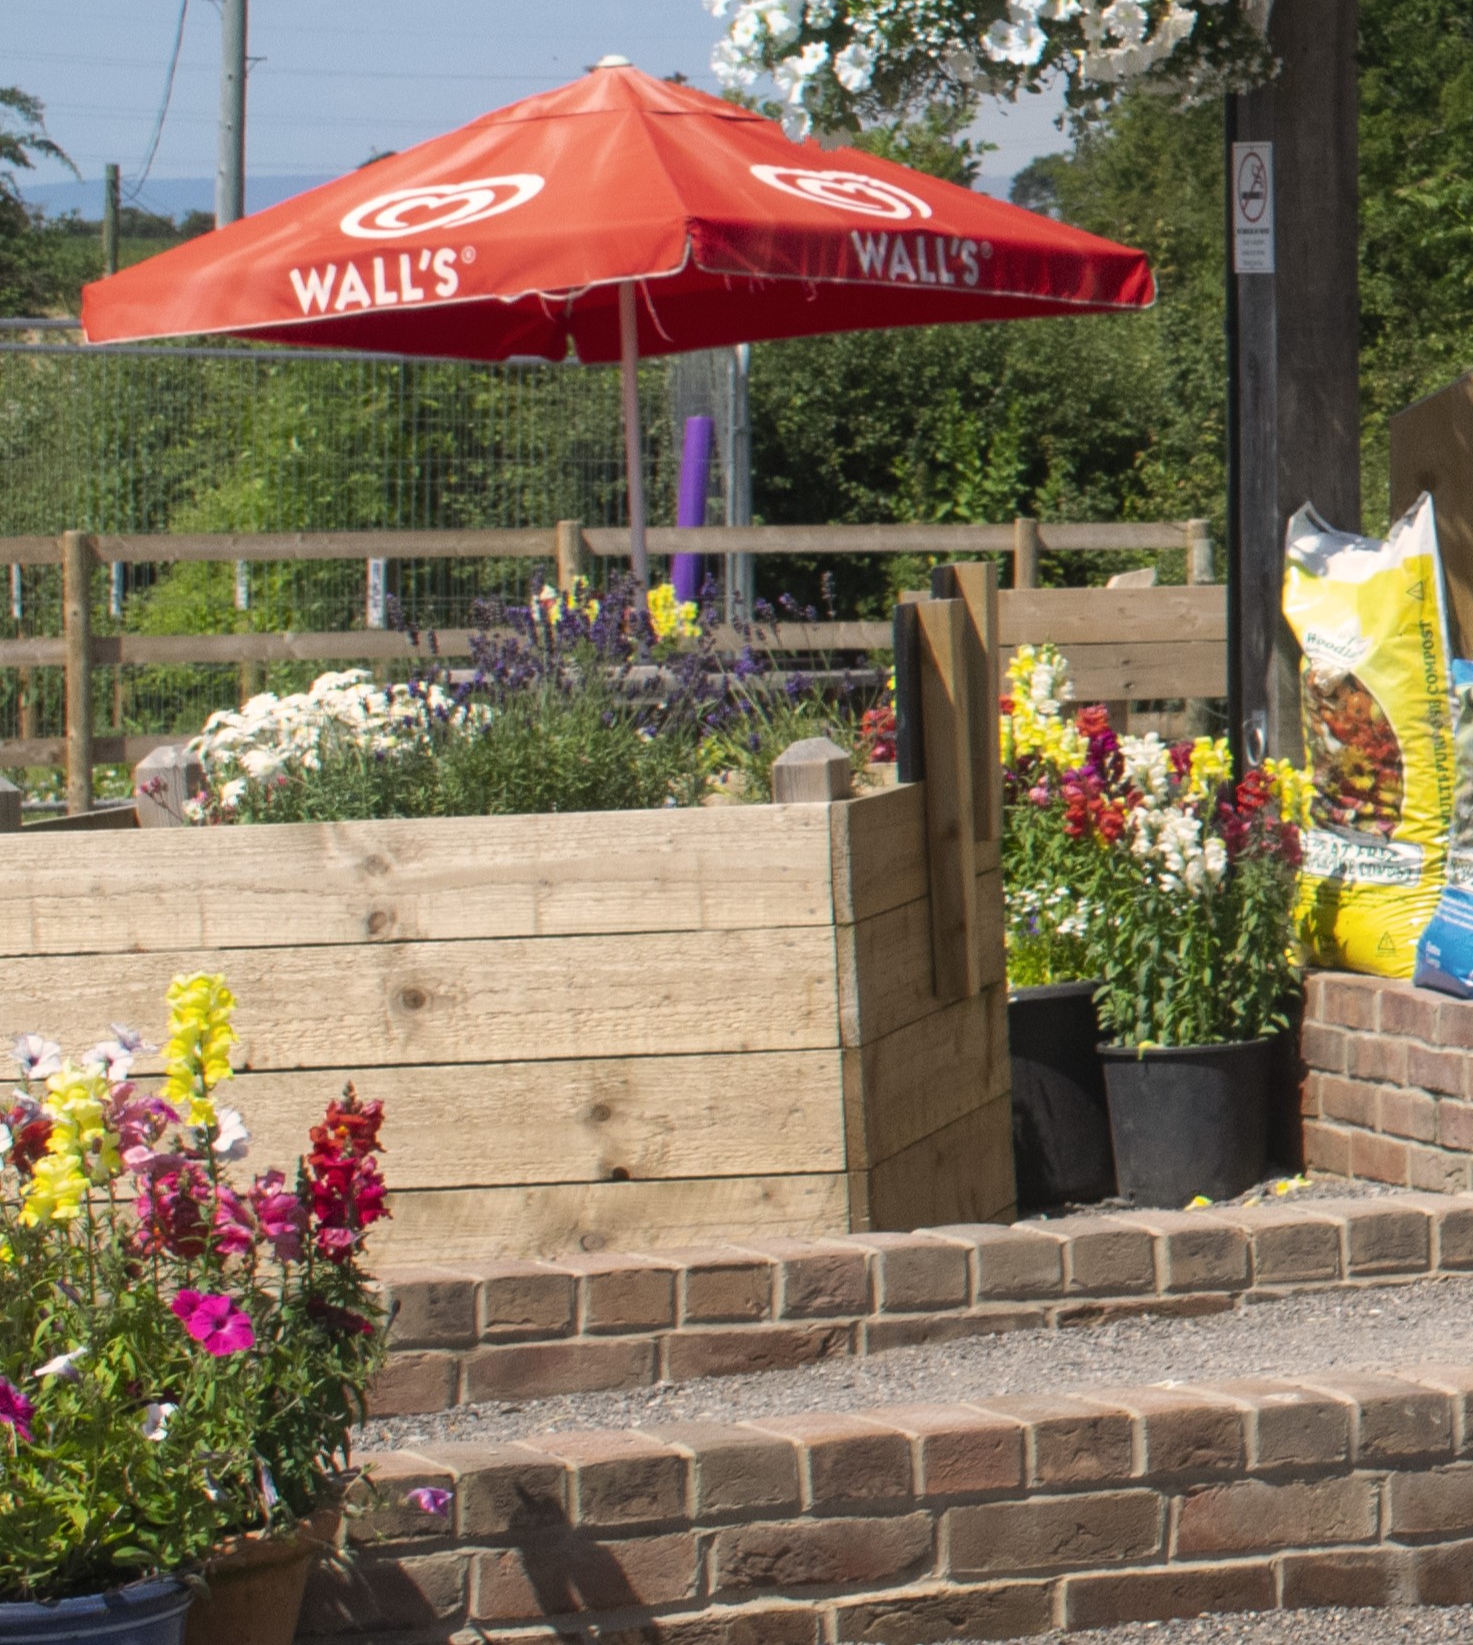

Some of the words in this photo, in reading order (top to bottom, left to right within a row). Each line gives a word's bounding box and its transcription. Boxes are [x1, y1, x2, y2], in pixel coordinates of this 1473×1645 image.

[288, 247, 460, 316] WALL'S
[850, 229, 980, 287] WALL'S
[1419, 619, 1438, 696] COMPOST
